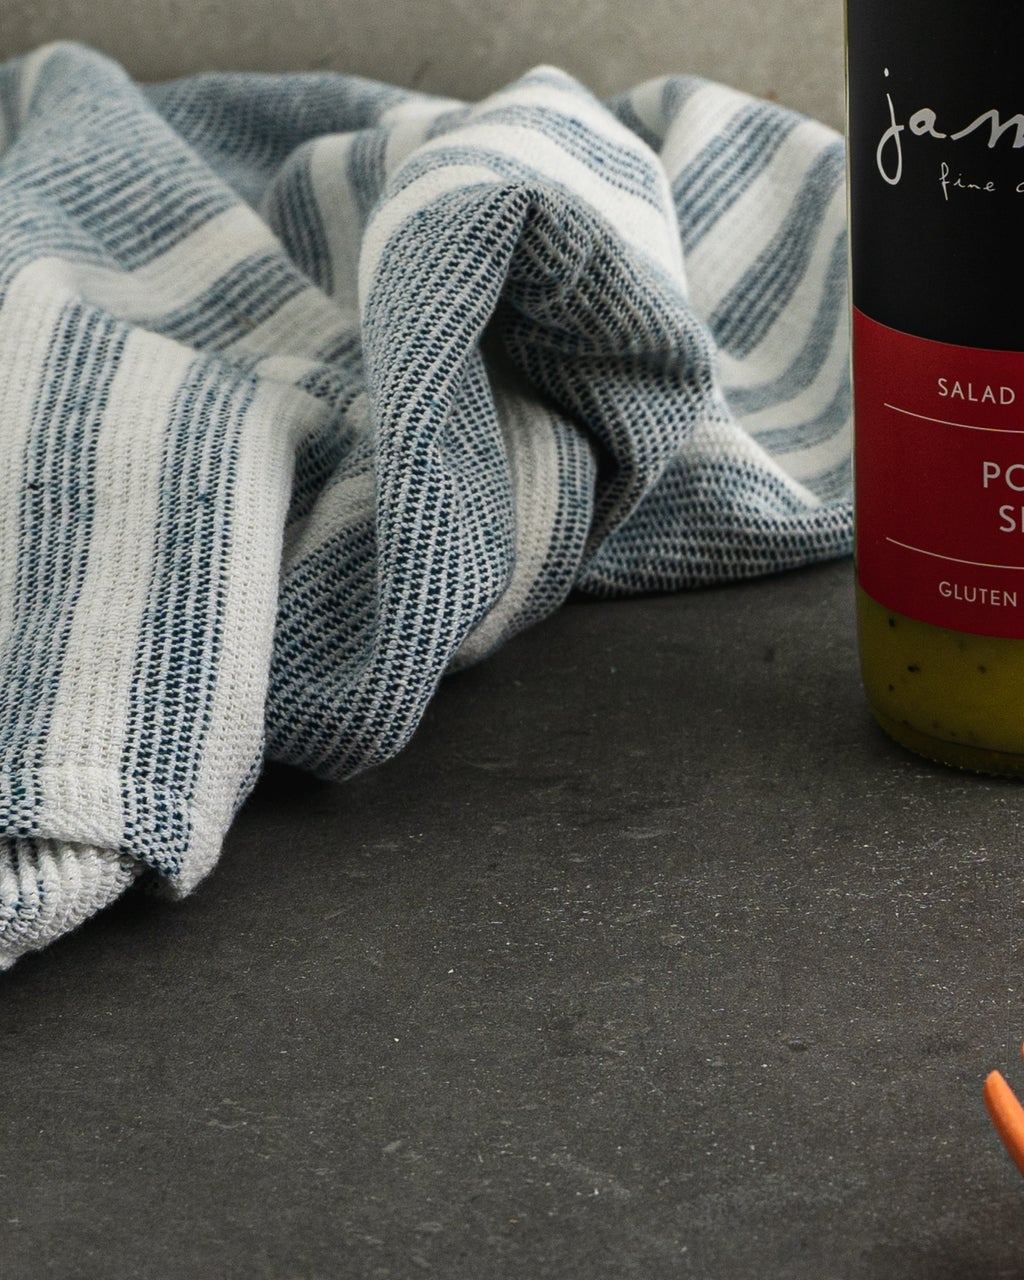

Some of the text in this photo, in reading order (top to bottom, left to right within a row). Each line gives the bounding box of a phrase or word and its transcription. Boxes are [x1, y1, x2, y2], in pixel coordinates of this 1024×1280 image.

[938, 161, 996, 201] fine
[937, 377, 1016, 405] SALAD
[938, 580, 1017, 607] GLUTEN
